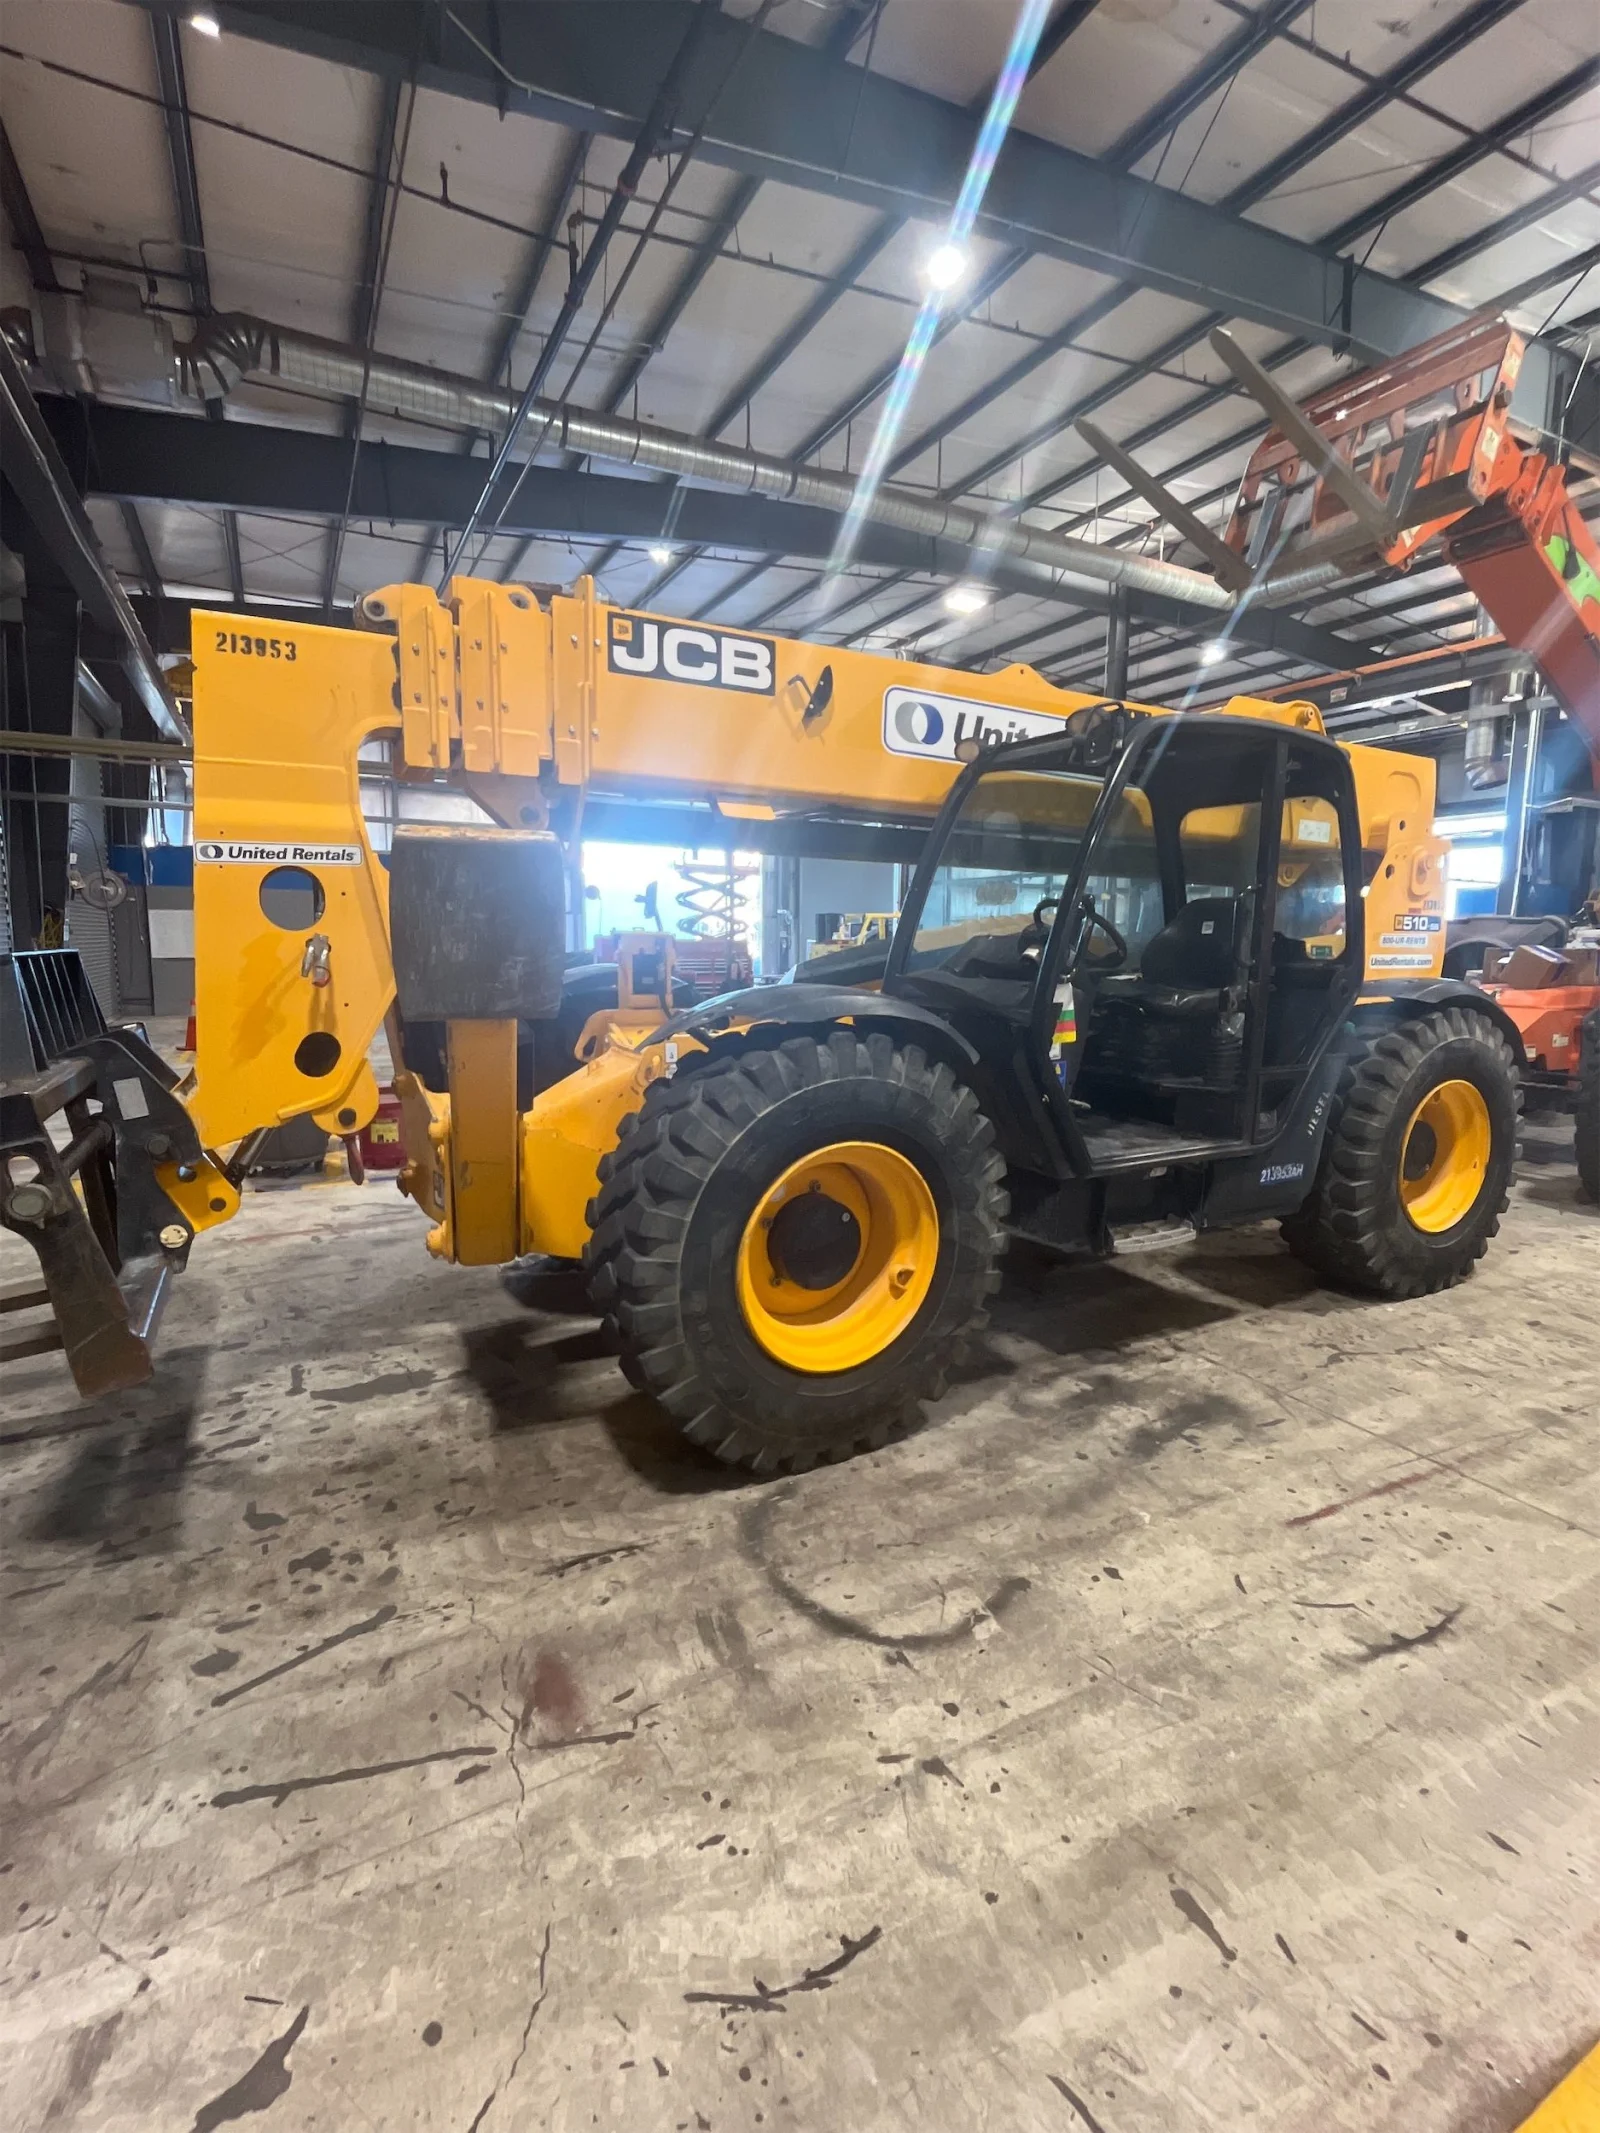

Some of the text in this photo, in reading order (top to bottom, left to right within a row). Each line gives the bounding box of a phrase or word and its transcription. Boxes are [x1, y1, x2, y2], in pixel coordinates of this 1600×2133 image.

[215, 631, 297, 662] 213953
[613, 623, 772, 690] JCB
[954, 712, 1030, 746] Unit
[228, 845, 355, 861] United Rentals
